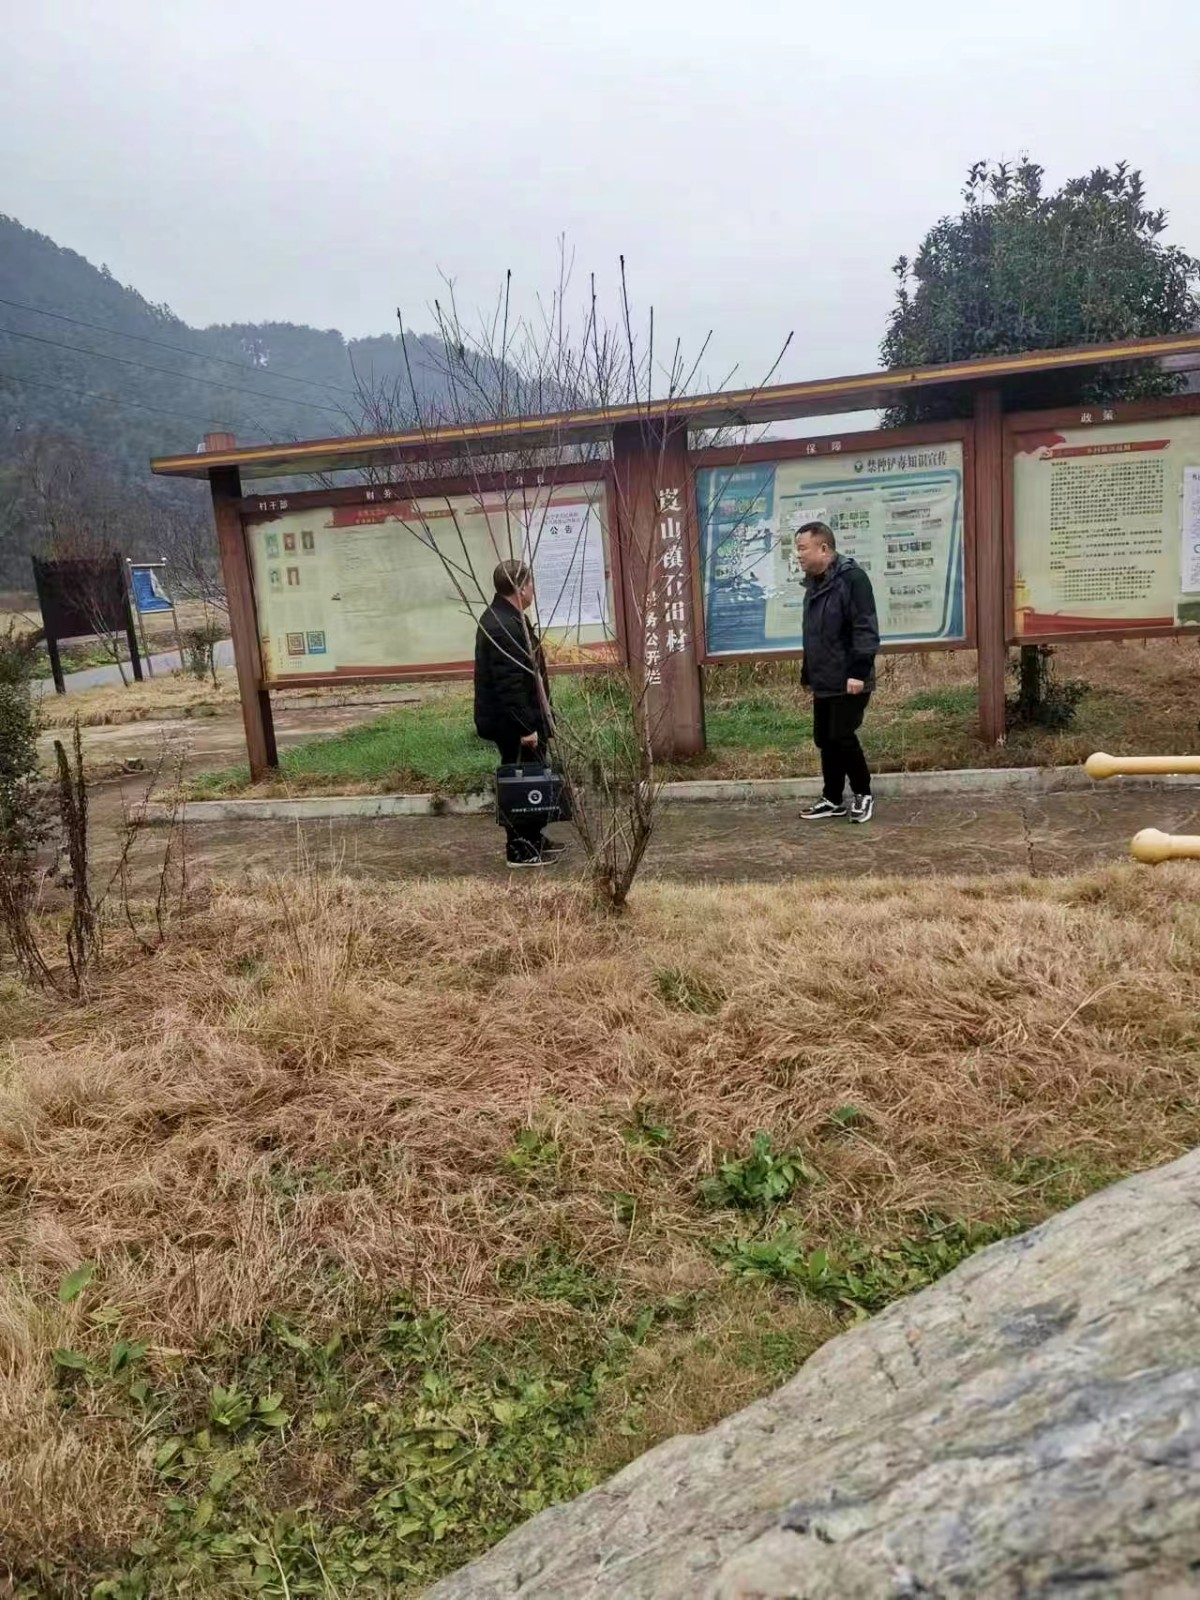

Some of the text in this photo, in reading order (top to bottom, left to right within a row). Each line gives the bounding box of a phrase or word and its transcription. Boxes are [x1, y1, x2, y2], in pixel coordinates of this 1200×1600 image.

[1080, 410, 1114, 423] 政策
[259, 500, 288, 511] 村干部
[550, 525, 572, 535] 公告
